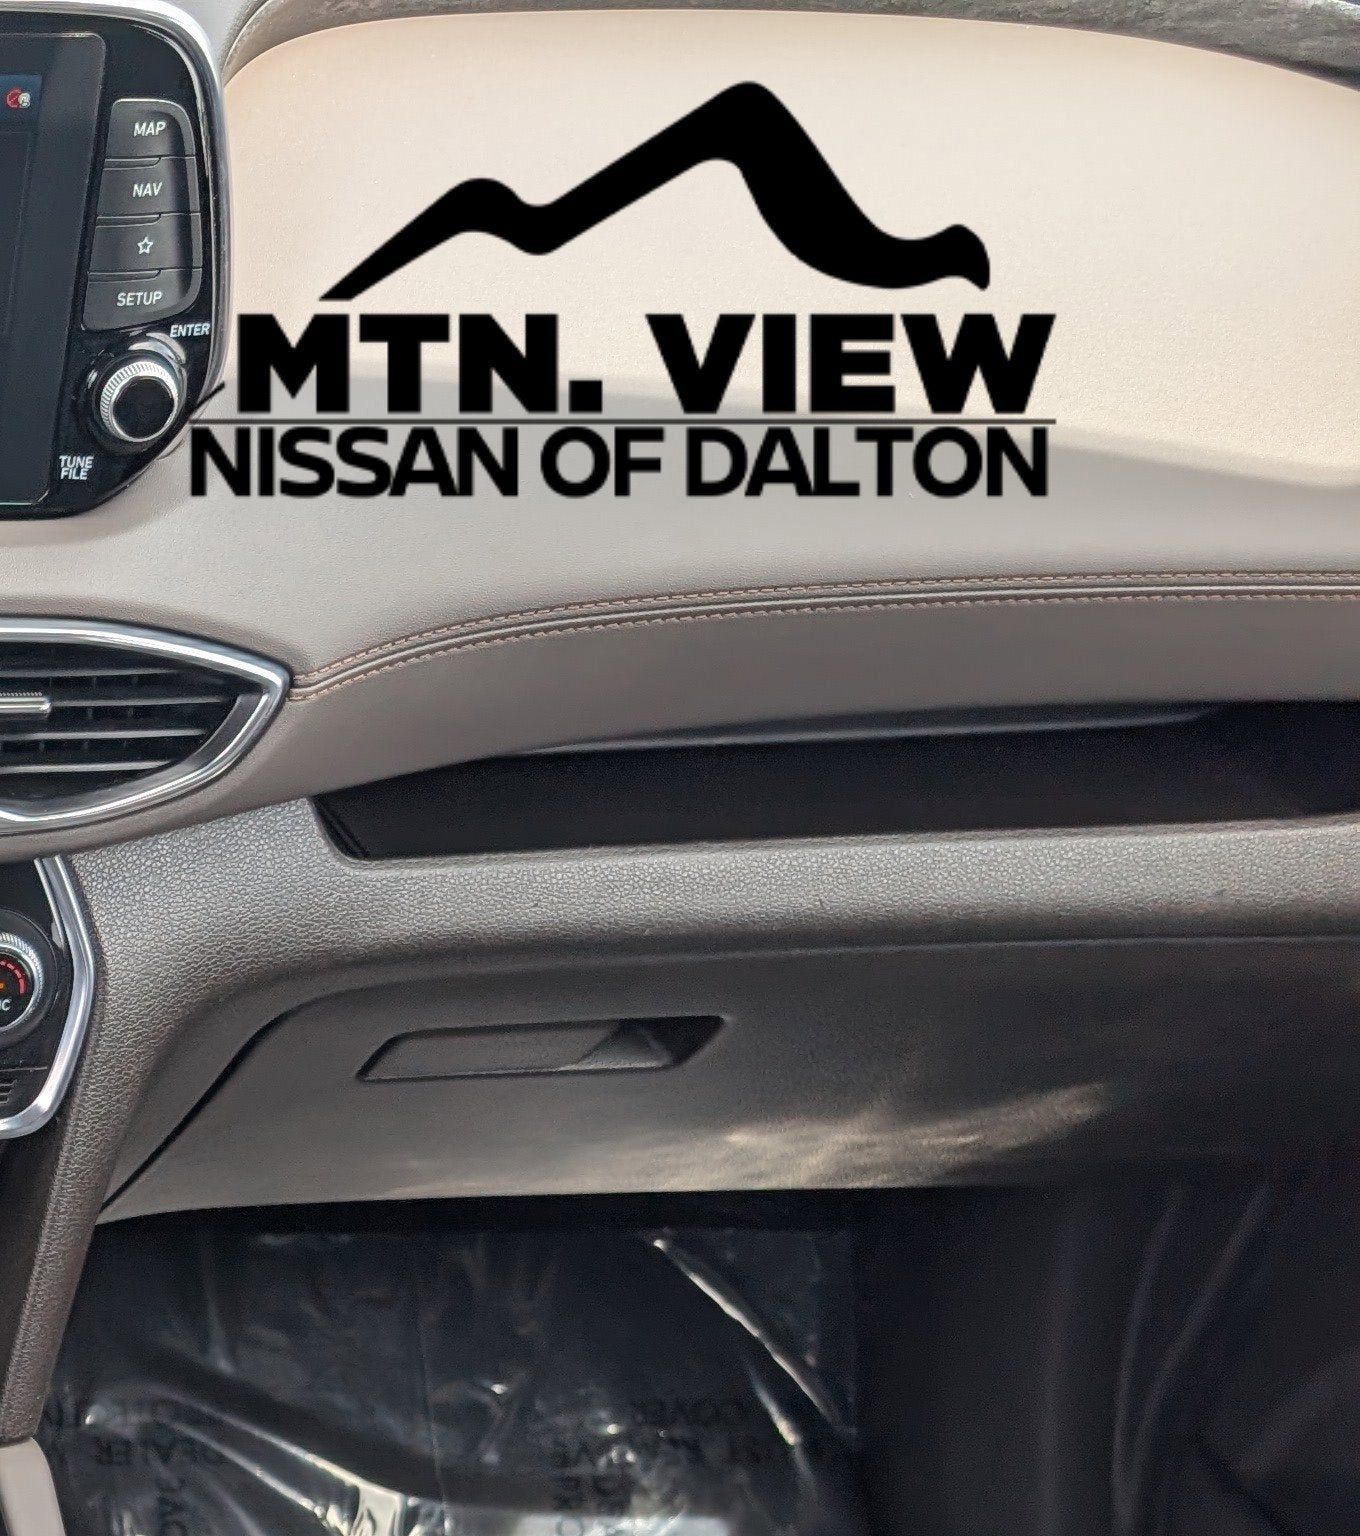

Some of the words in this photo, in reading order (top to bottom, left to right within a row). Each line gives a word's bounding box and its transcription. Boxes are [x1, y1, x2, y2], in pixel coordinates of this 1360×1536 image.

[133, 121, 166, 137] MAP
[133, 183, 162, 197] NAV
[117, 291, 163, 306] SETUP
[170, 323, 210, 338] ENTER
[59, 456, 93, 468] TUNE
[61, 466, 89, 480] FILE
